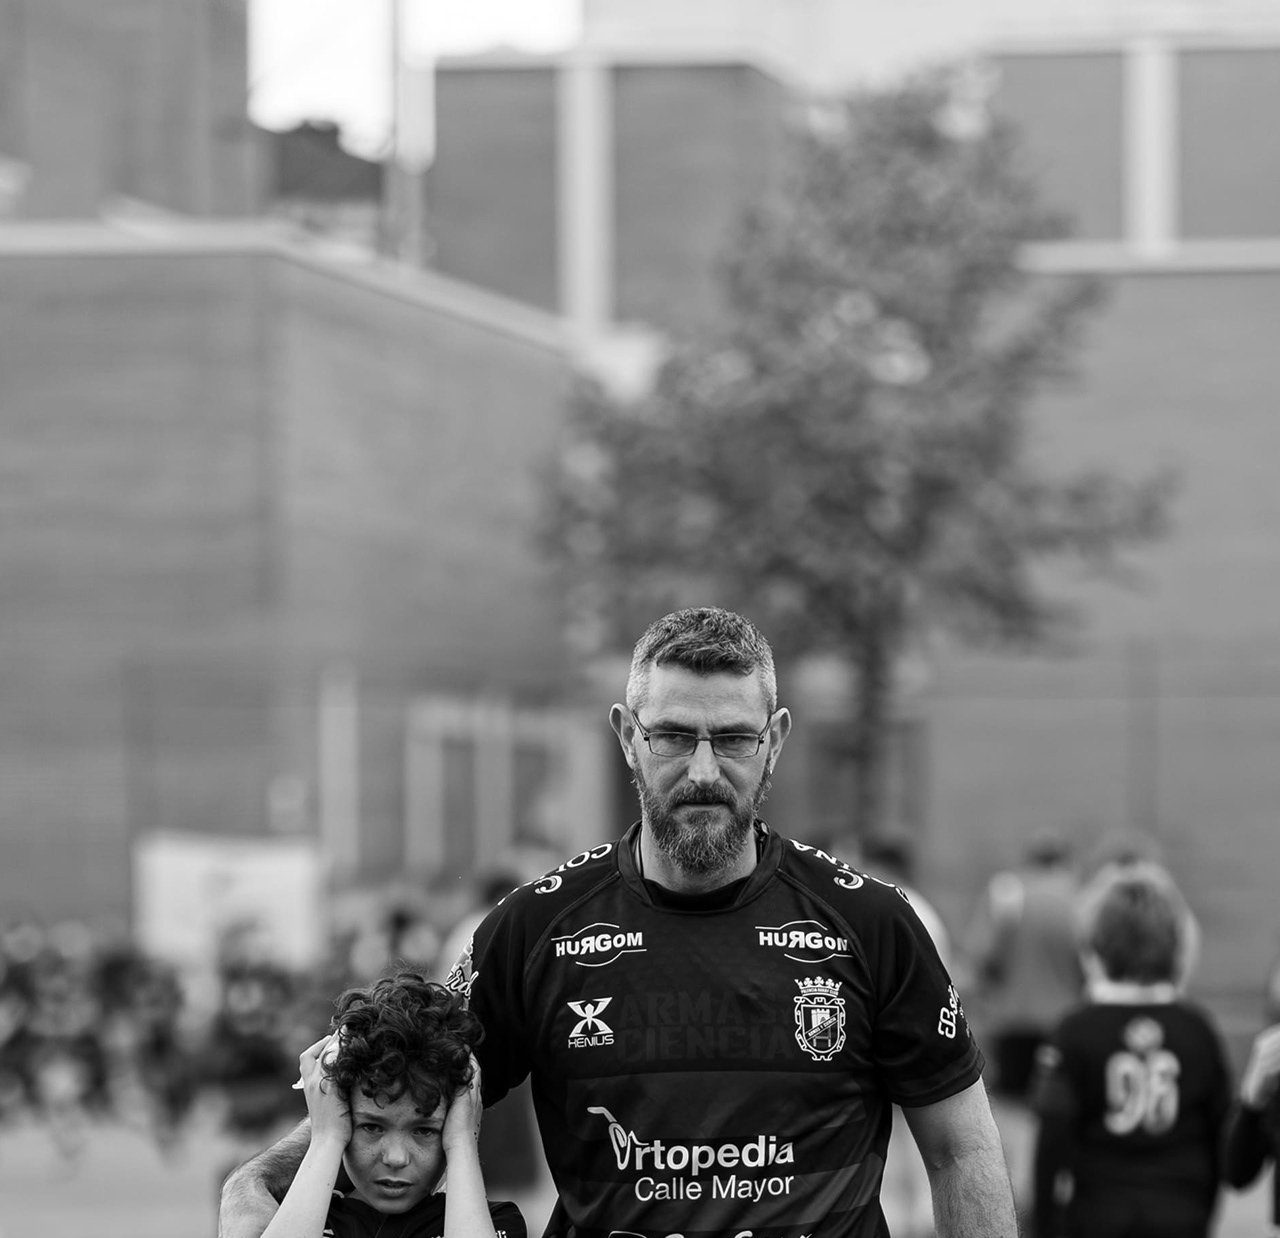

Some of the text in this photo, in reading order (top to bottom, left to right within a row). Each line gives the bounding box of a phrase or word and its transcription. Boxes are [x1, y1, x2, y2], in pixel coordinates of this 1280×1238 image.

[555, 932, 643, 957] HURGOM
[634, 1175, 794, 1202] Calle Mayor
